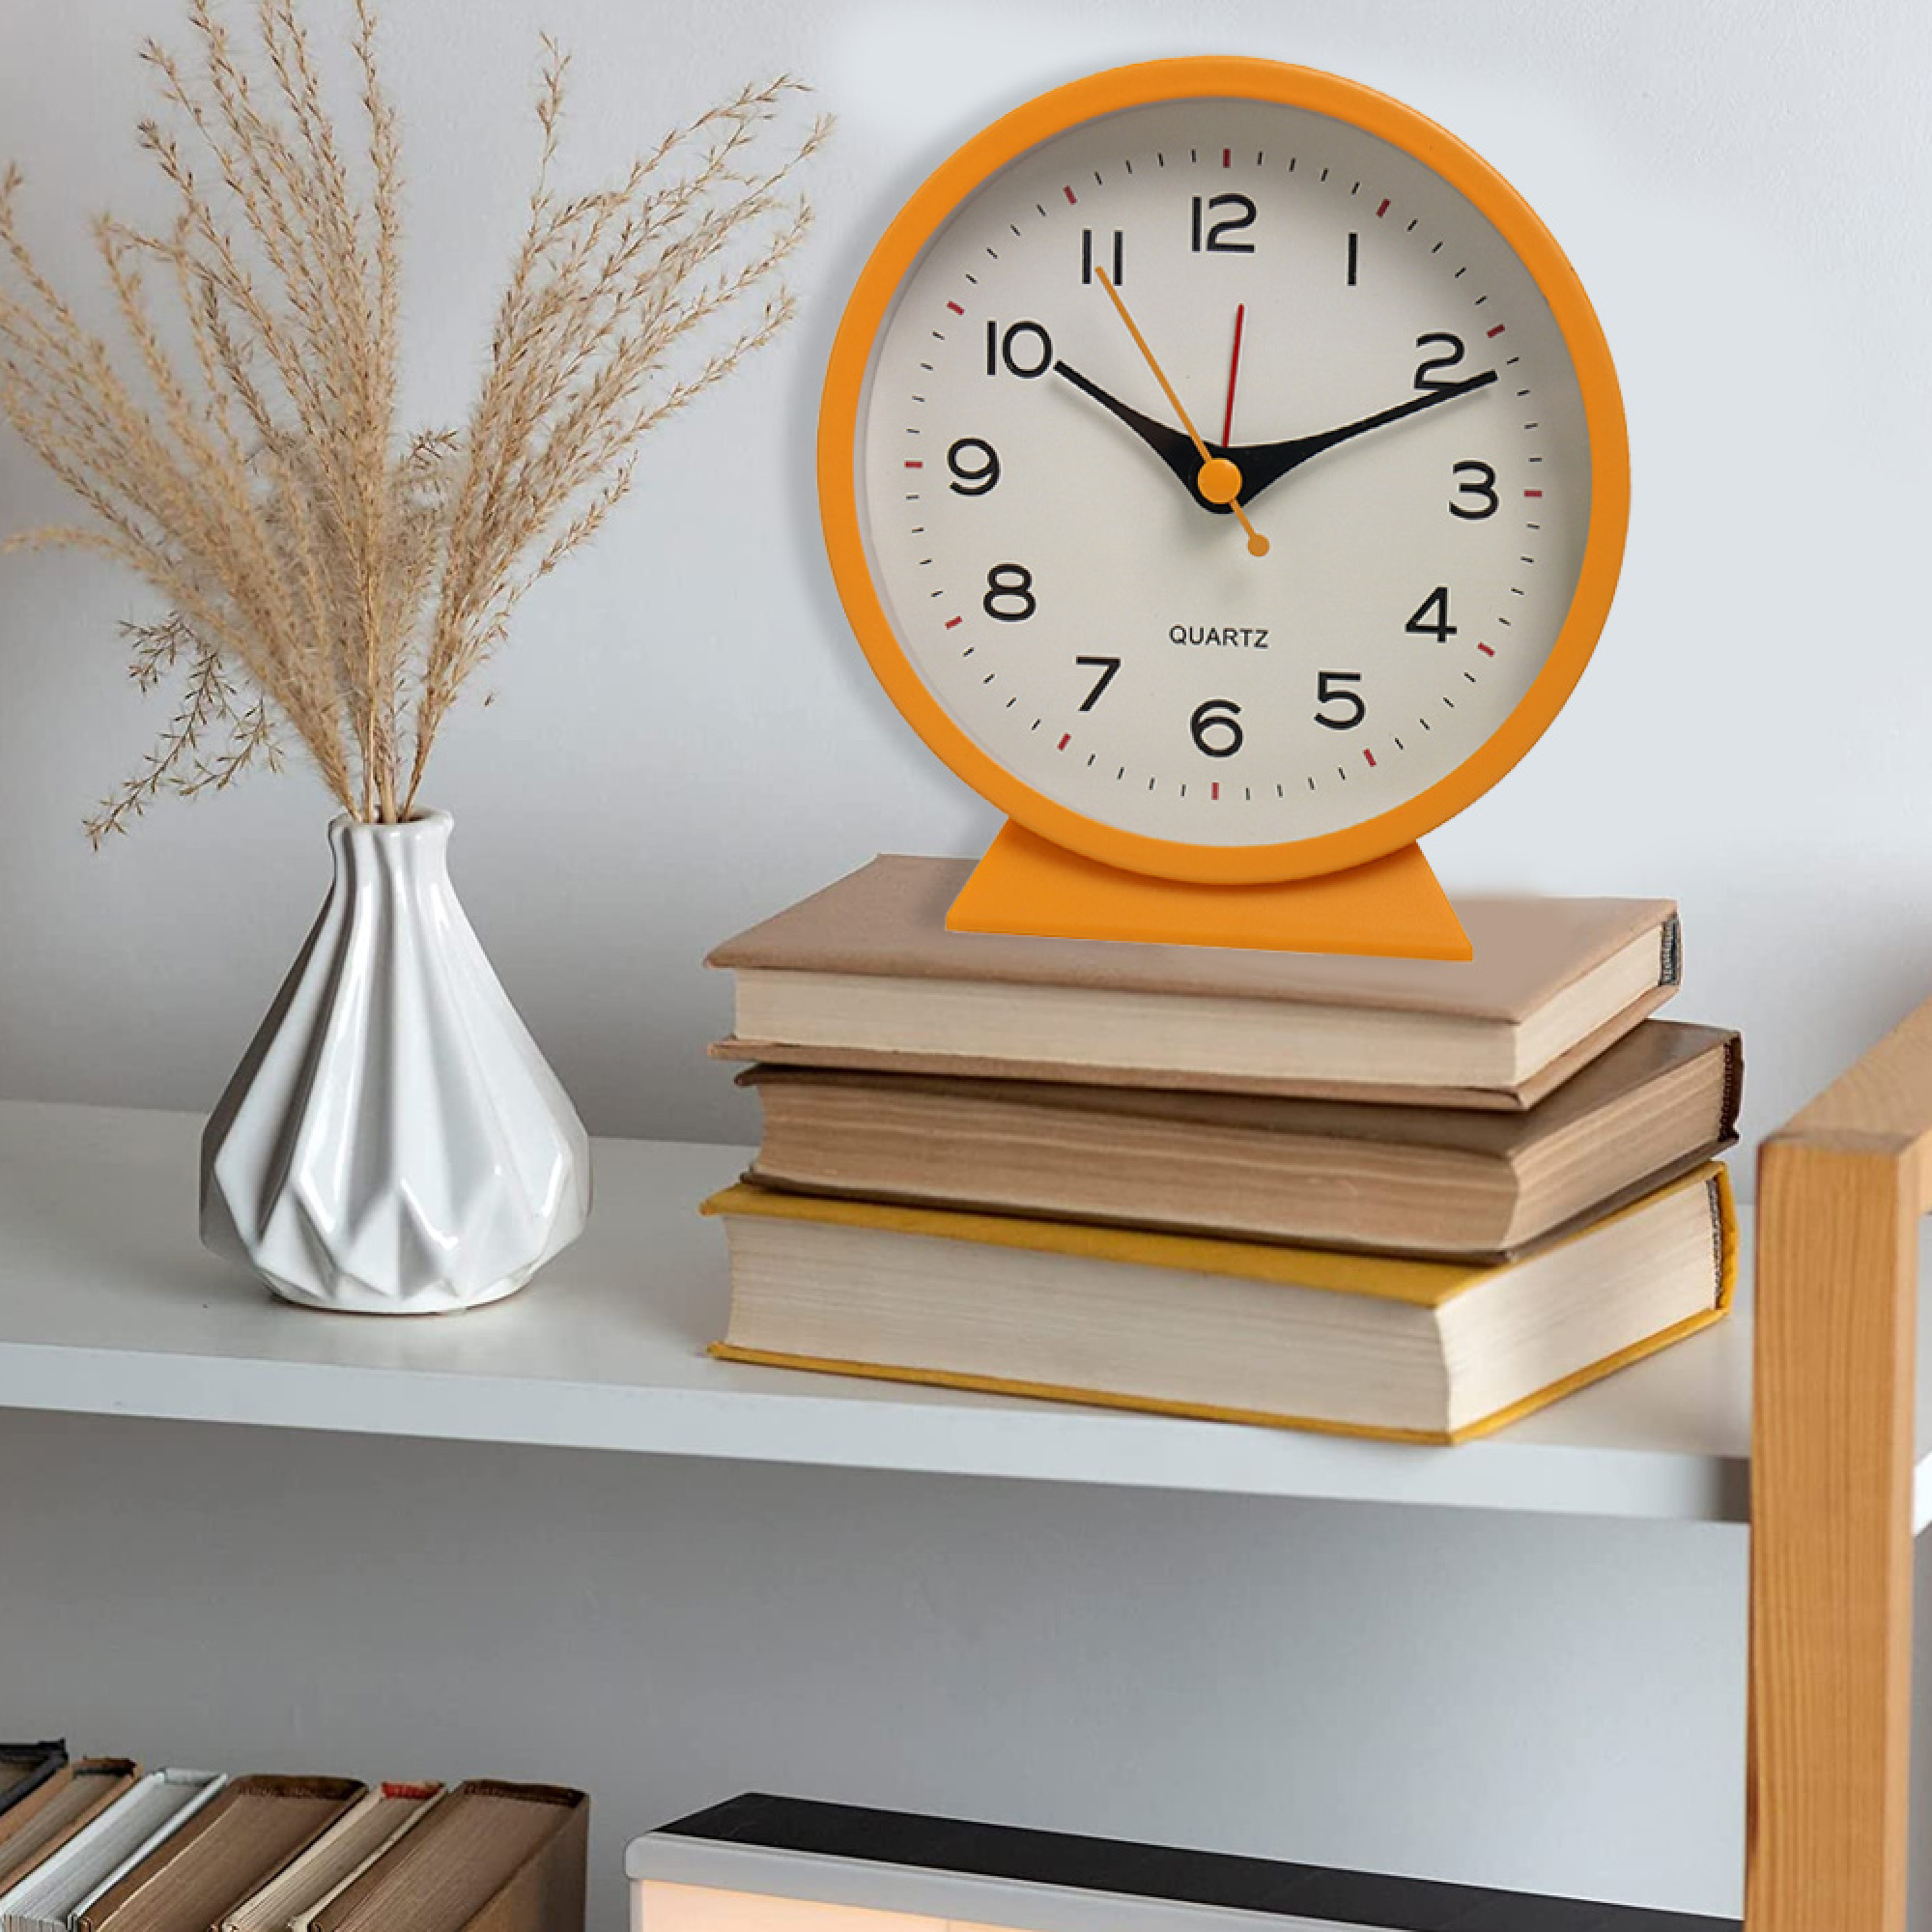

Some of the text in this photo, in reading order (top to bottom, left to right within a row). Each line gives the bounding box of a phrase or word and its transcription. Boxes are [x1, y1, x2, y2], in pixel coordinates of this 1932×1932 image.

[1192, 193, 1256, 253] 12
[1082, 230, 1122, 286] 11
[1349, 232, 1357, 286] 1
[987, 321, 1052, 379] 10
[1414, 332, 1464, 390] 2
[947, 439, 1001, 497] 9
[1449, 460, 1499, 520] 3
[983, 564, 1036, 622] 8
[1405, 587, 1457, 643] 4
[1169, 626, 1267, 647] QUARTZ
[1076, 657, 1121, 711] 7
[1314, 672, 1366, 730] 5
[1190, 699, 1242, 757] 6
